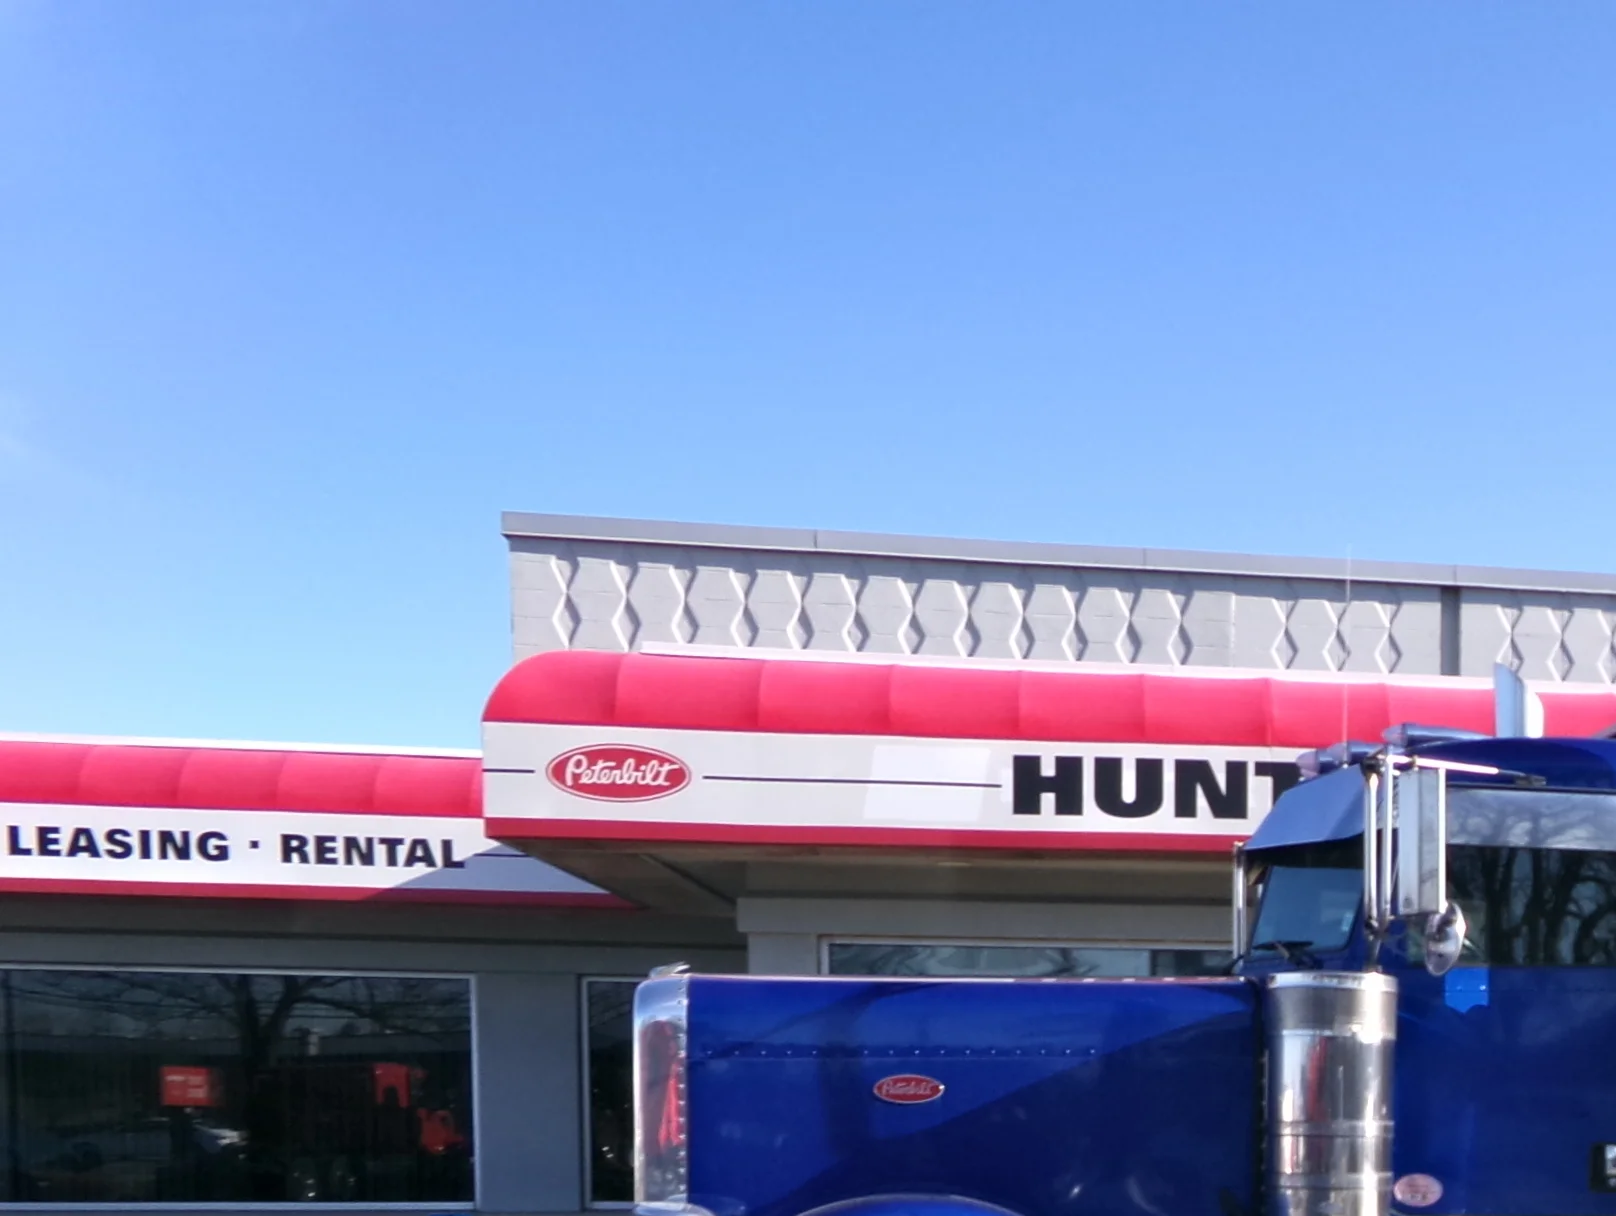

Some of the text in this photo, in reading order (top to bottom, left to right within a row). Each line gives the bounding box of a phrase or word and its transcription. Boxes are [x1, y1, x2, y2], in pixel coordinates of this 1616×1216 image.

[564, 754, 680, 787] Peterbilt
[6, 825, 466, 869] LEASING RENTAL
